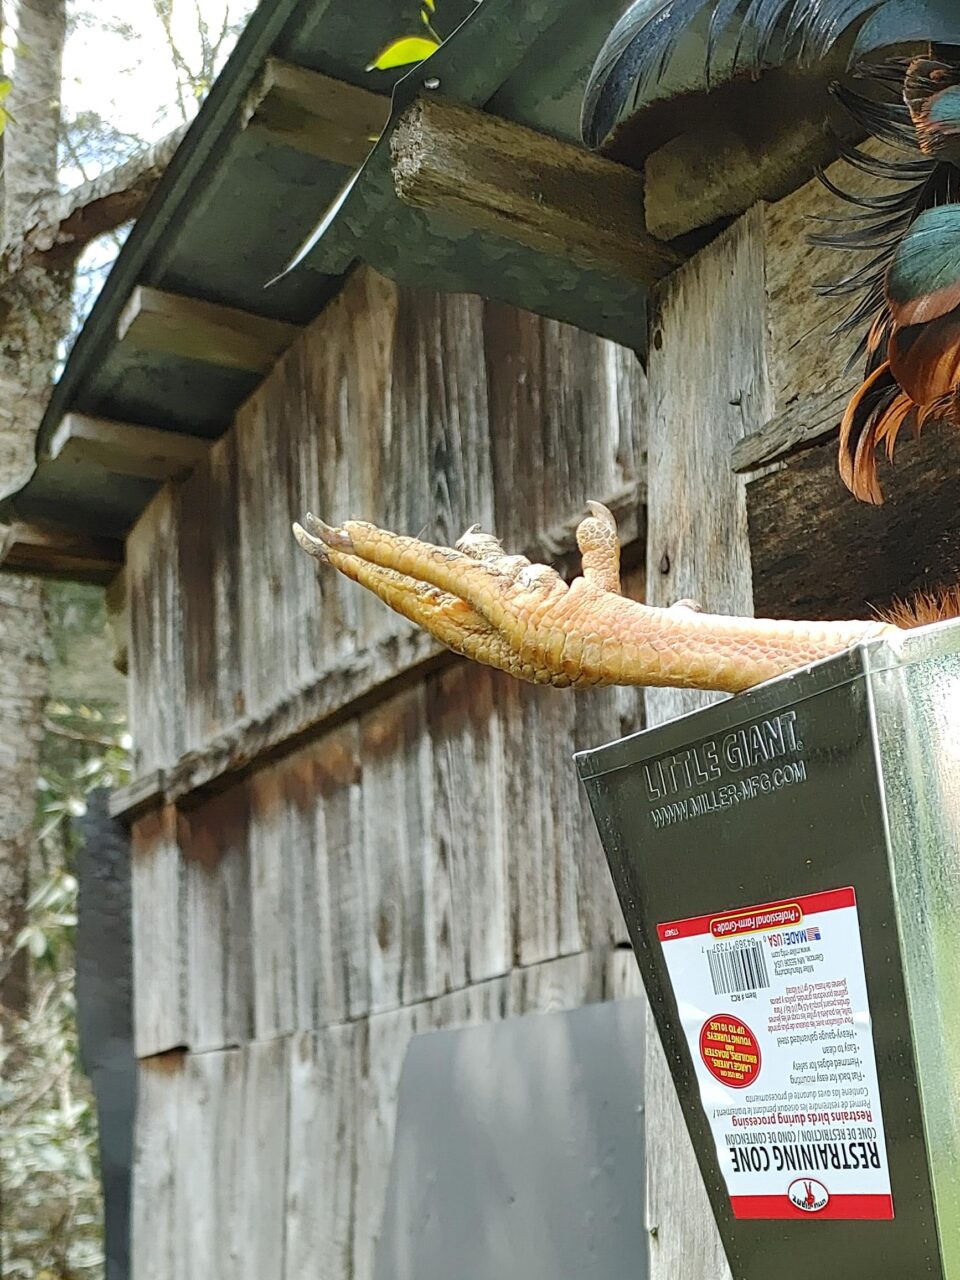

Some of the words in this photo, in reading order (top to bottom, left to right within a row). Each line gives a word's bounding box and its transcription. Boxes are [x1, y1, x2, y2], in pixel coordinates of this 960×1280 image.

[642, 740, 721, 802] LITTLE
[721, 710, 798, 773] GIANT
[650, 760, 808, 829] WWW.MILLER-MFG.COM
[756, 910, 794, 926] Professional
[717, 918, 755, 934] Farm-Grade
[768, 934, 782, 947] USA
[786, 930, 807, 945] MADE
[710, 1022, 720, 1030] LBS
[707, 1032, 731, 1042] TURKEYS
[790, 1031, 818, 1046] galvanized
[818, 1029, 854, 1041] Heavy-gauge
[731, 1036, 752, 1046] YOUNG
[777, 1036, 789, 1047] steel
[822, 1046, 836, 1055] clean
[838, 1045, 843, 1053] to
[844, 1042, 857, 1053] Easy
[704, 1048, 729, 1059] ROASTER
[733, 1062, 751, 1072] LARGE
[793, 1061, 808, 1072] safety
[817, 1058, 833, 1070] edges
[834, 1058, 860, 1069] Hemmed
[790, 1075, 816, 1085] mounting
[816, 1073, 828, 1082] easy
[838, 1072, 851, 1083] back
[851, 1071, 862, 1081] Flat
[841, 1087, 868, 1096] Contiene
[788, 1093, 793, 1102] el
[747, 1107, 752, 1115] le
[753, 1104, 776, 1115] pendant
[777, 1104, 799, 1113] oiseaux
[800, 1104, 808, 1112] les
[841, 1101, 848, 1110] de
[732, 1113, 776, 1130] processing
[777, 1113, 806, 1126] during
[807, 1113, 830, 1126] birds
[831, 1110, 872, 1124] Restrains
[767, 1132, 777, 1143] DE
[778, 1131, 796, 1143] CONO
[801, 1129, 846, 1142] RESTRICTION
[846, 1128, 856, 1140] DE
[730, 1146, 770, 1172] CONE
[772, 1142, 881, 1171] RESTRAINING
